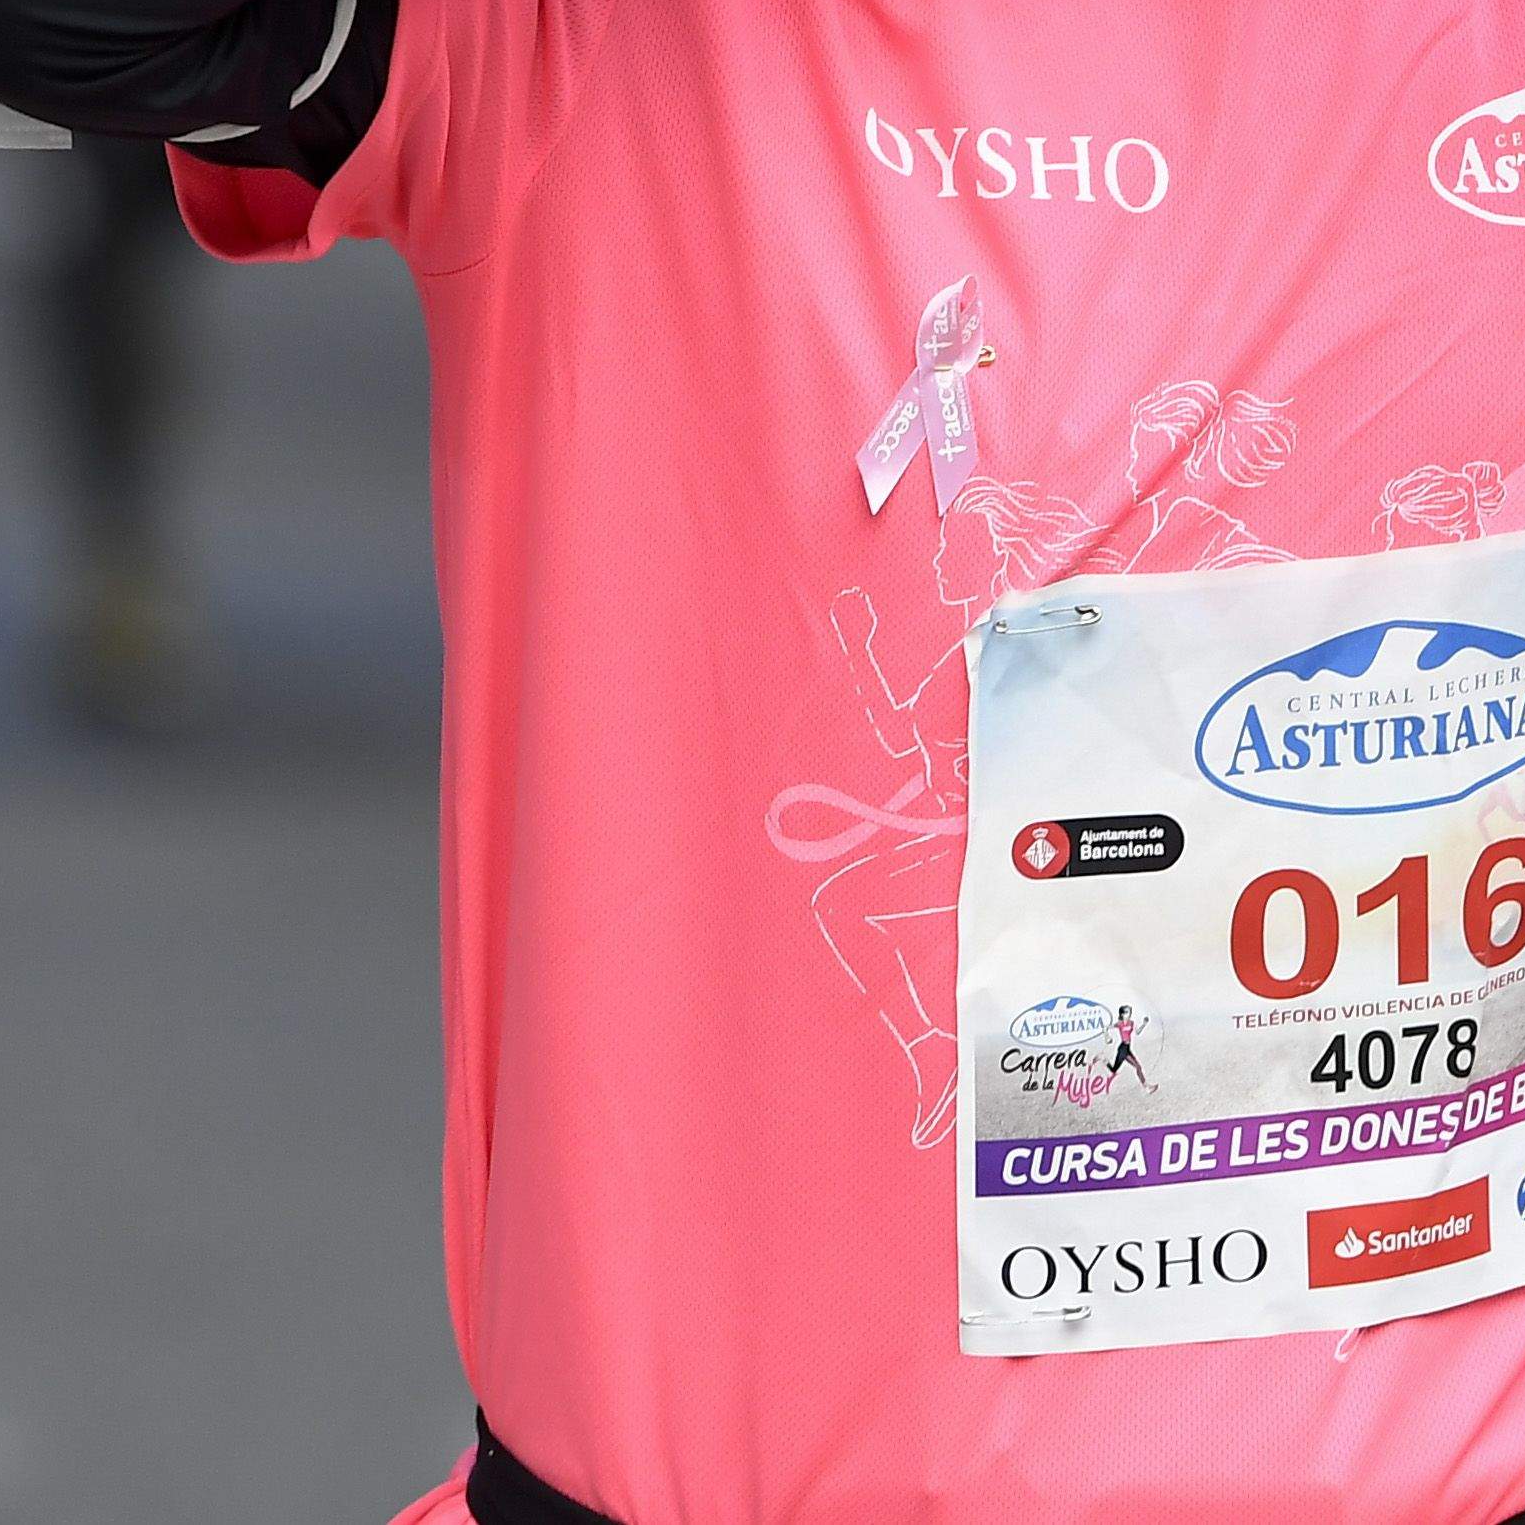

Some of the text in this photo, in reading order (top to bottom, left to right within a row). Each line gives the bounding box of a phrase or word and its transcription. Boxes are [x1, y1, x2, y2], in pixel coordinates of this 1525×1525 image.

[865, 107, 1169, 213] OYSHO
[1287, 686, 1414, 713] CENTRAL
[1080, 825, 1164, 844] Ajuntament de
[1080, 840, 1164, 861] Barcelona
[1018, 1016, 1104, 1039] ASTURIANA
[1232, 1007, 1336, 1030] TELÉFONO
[1342, 994, 1445, 1019] VIOLENCIA
[1450, 989, 1473, 1006] DE
[1001, 1048, 1087, 1074] Carrera
[1310, 1019, 1478, 1093] 4078
[1023, 1065, 1117, 1108] de la Mujer
[1002, 1138, 1147, 1186] CURSA
[1160, 1129, 1219, 1174] DE
[1229, 1119, 1309, 1167] LES
[1320, 1101, 1462, 1155] DONES
[1464, 1082, 1508, 1131] DE
[1368, 1213, 1474, 1255] Santander
[1000, 1229, 1268, 1300] OYSHO
